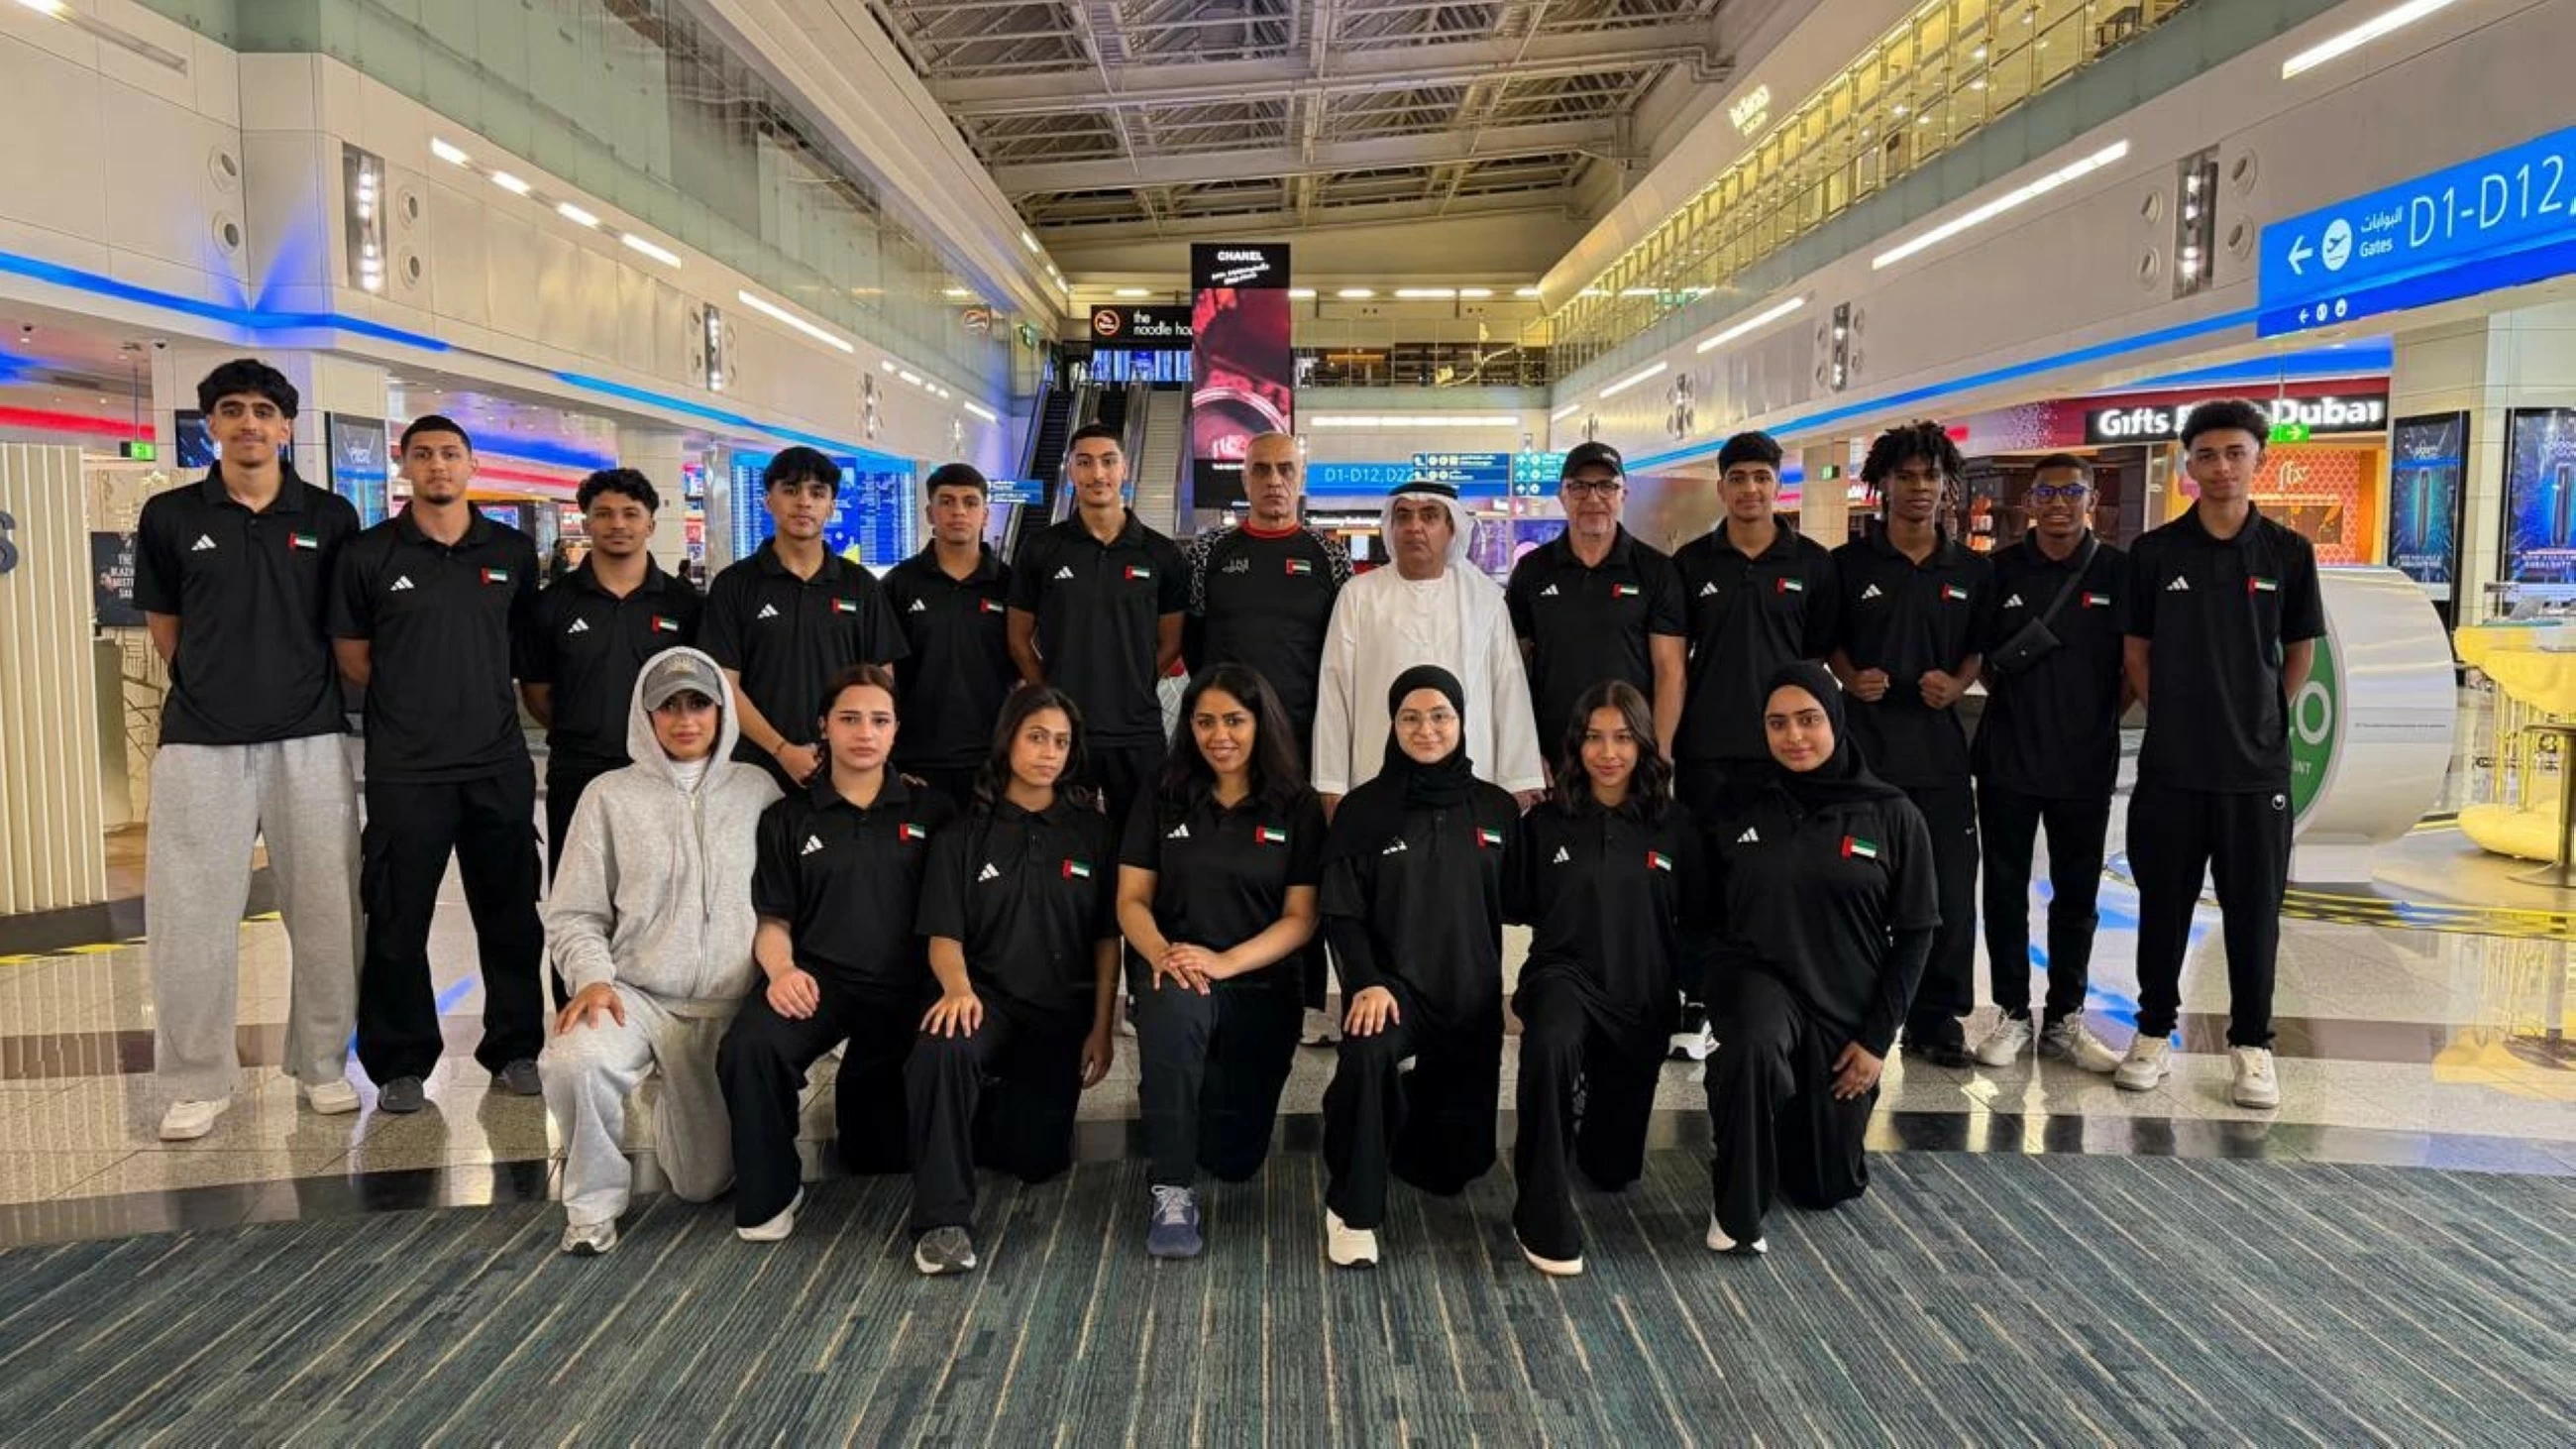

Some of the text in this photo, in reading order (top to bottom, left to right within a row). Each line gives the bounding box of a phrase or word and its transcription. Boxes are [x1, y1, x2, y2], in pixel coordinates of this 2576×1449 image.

[2359, 237, 2394, 258] Gates
[1217, 251, 1264, 261] CHANEL
[1132, 309, 1150, 324] the
[1132, 320, 1172, 335] noodle
[2099, 407, 2170, 436] Gifts
[2273, 397, 2384, 424] Dubai
